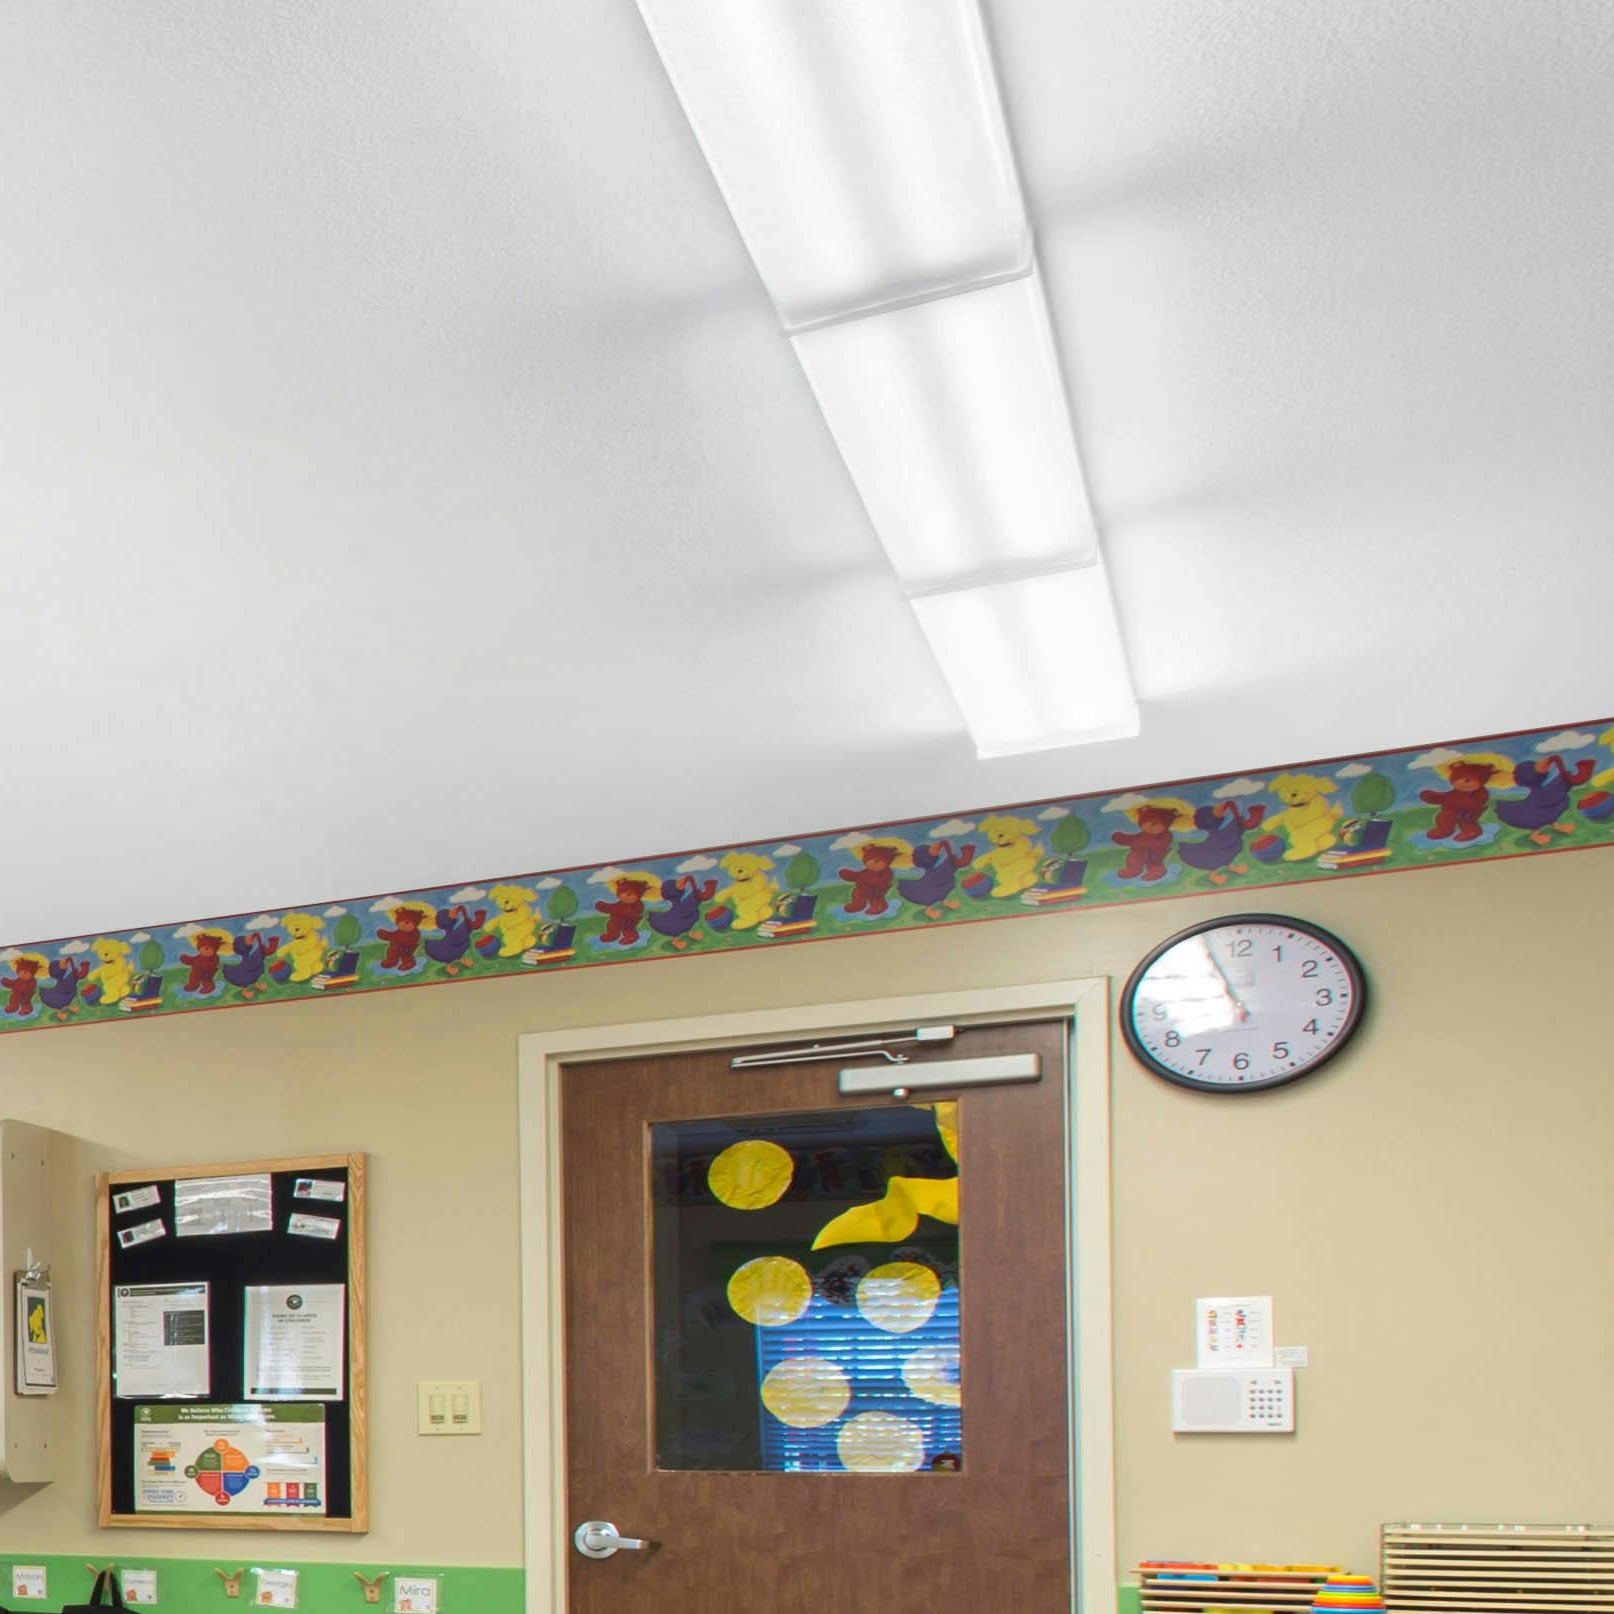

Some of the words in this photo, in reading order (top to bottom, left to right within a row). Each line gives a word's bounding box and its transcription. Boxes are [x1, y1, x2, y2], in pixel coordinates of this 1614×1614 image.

[1226, 939, 1253, 958] 12
[1271, 945, 1282, 962] 1
[1301, 960, 1319, 978] 2
[1315, 988, 1332, 1006] 3
[1152, 1006, 1167, 1022] 9
[1301, 1018, 1319, 1035] 4
[1164, 1030, 1181, 1048] 8
[1195, 1049, 1212, 1066] 7
[1272, 1041, 1289, 1059] 5
[1232, 1052, 1249, 1070] 6
[399, 1584, 431, 1597] Mira
